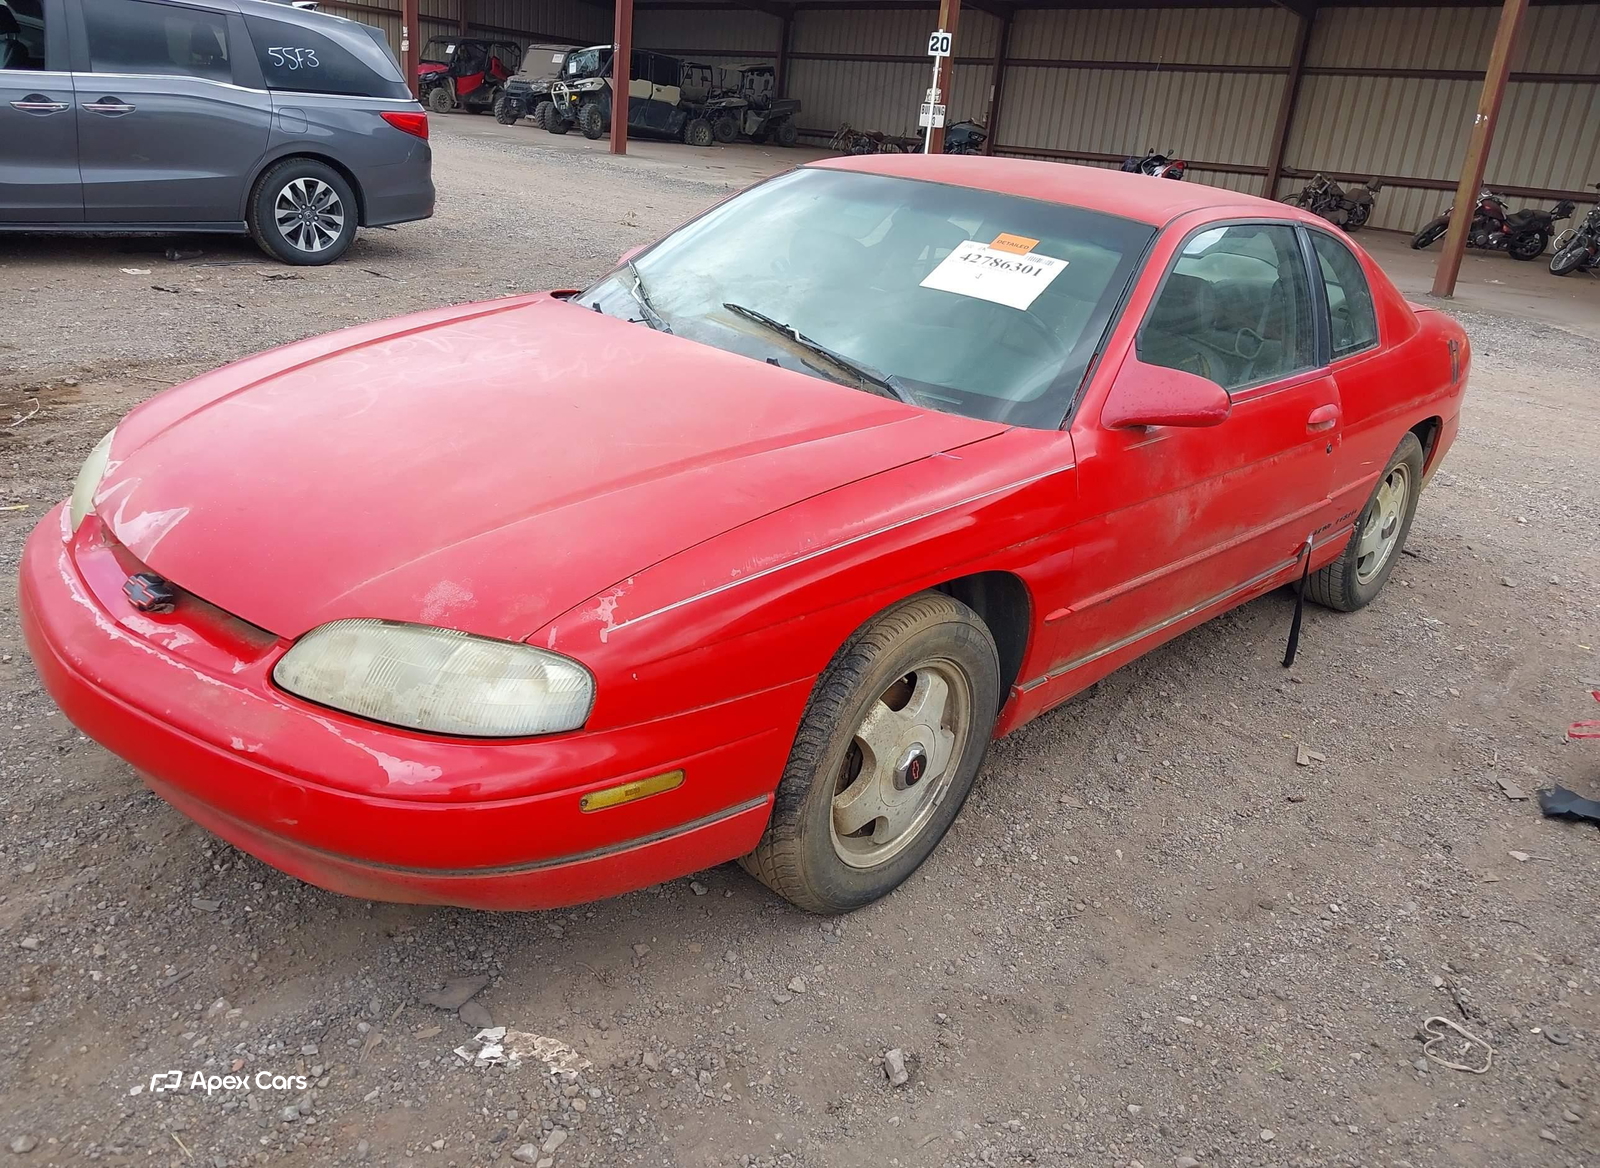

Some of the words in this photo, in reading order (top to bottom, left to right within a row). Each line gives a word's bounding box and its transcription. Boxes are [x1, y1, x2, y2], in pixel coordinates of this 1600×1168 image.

[930, 36, 949, 52] 20
[268, 46, 320, 70] 55F3
[922, 105, 945, 116] BUIDING
[996, 239, 1030, 250] DETAILED
[959, 253, 1043, 277] 42786301
